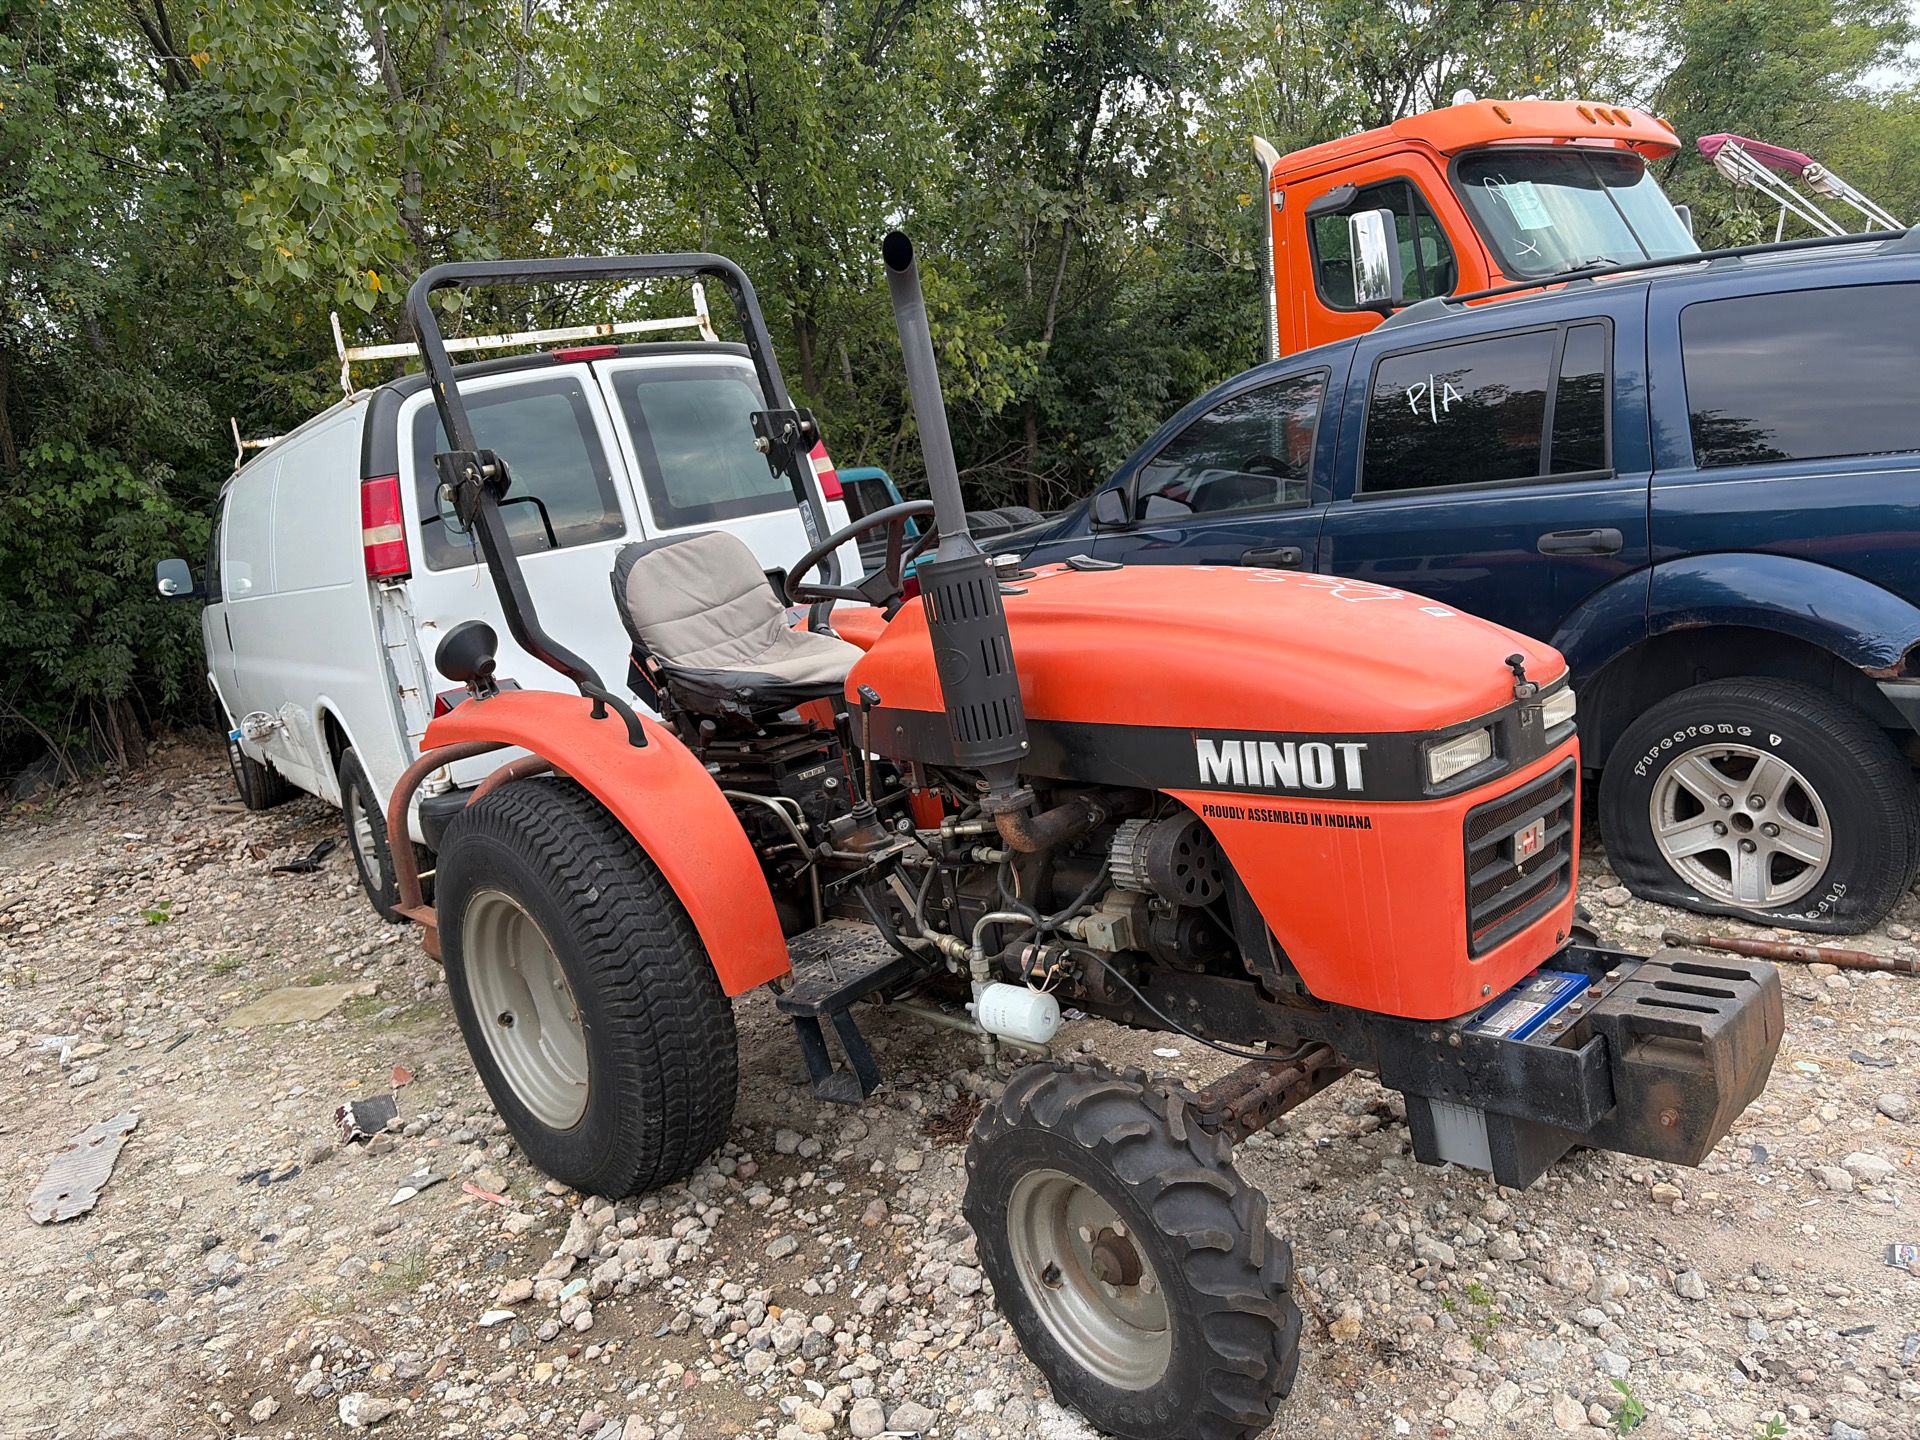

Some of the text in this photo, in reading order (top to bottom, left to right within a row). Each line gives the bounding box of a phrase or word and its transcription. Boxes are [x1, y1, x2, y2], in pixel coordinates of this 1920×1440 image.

[1406, 373, 1463, 424] P/A
[1196, 739, 1368, 791] MINOT
[1634, 723, 1752, 776] Firestone
[1202, 804, 1372, 830] PROUDLY ASSEMBLED IN INDIANA
